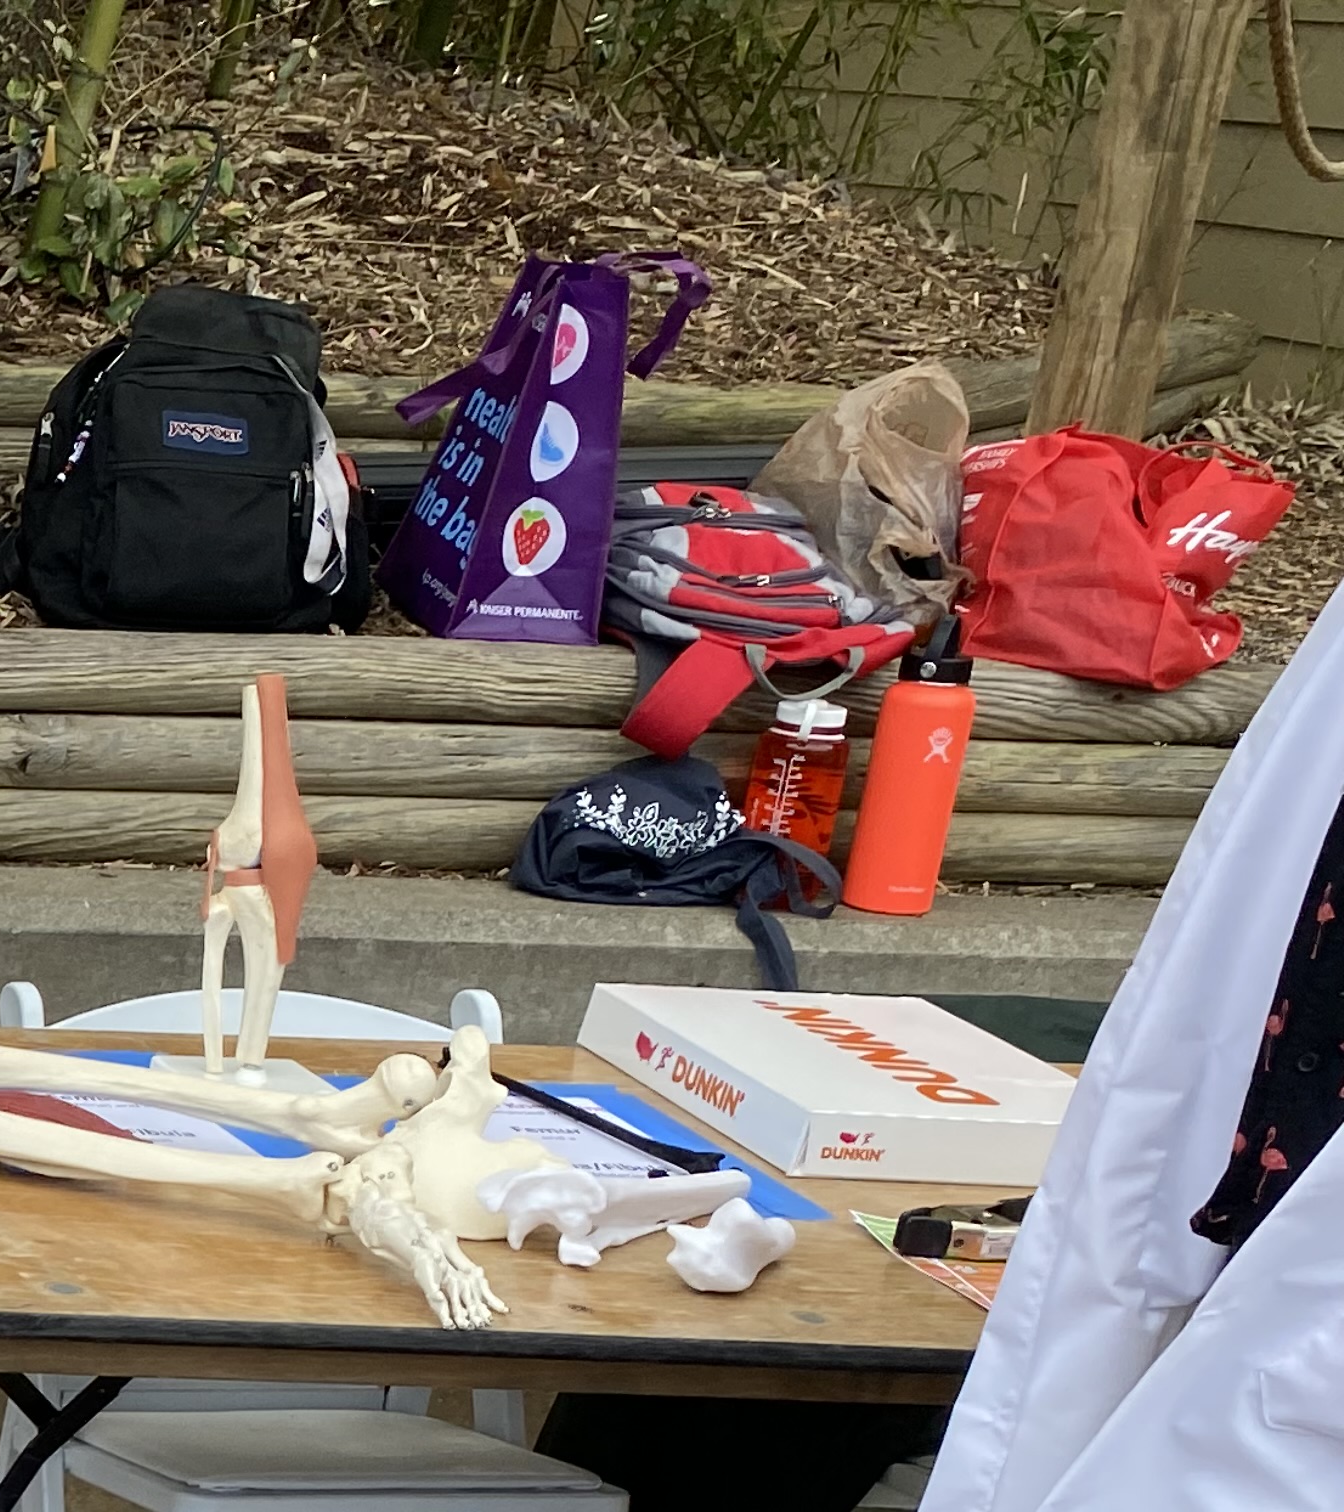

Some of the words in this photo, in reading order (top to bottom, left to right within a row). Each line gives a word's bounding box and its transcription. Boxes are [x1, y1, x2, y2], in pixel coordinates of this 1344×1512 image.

[438, 425, 463, 470] is
[457, 437, 485, 487] in
[414, 478, 447, 527] the
[480, 605, 512, 616] KAISER
[672, 1055, 745, 1117] DUNKIN'
[821, 1147, 886, 1161] DUNKIN'
